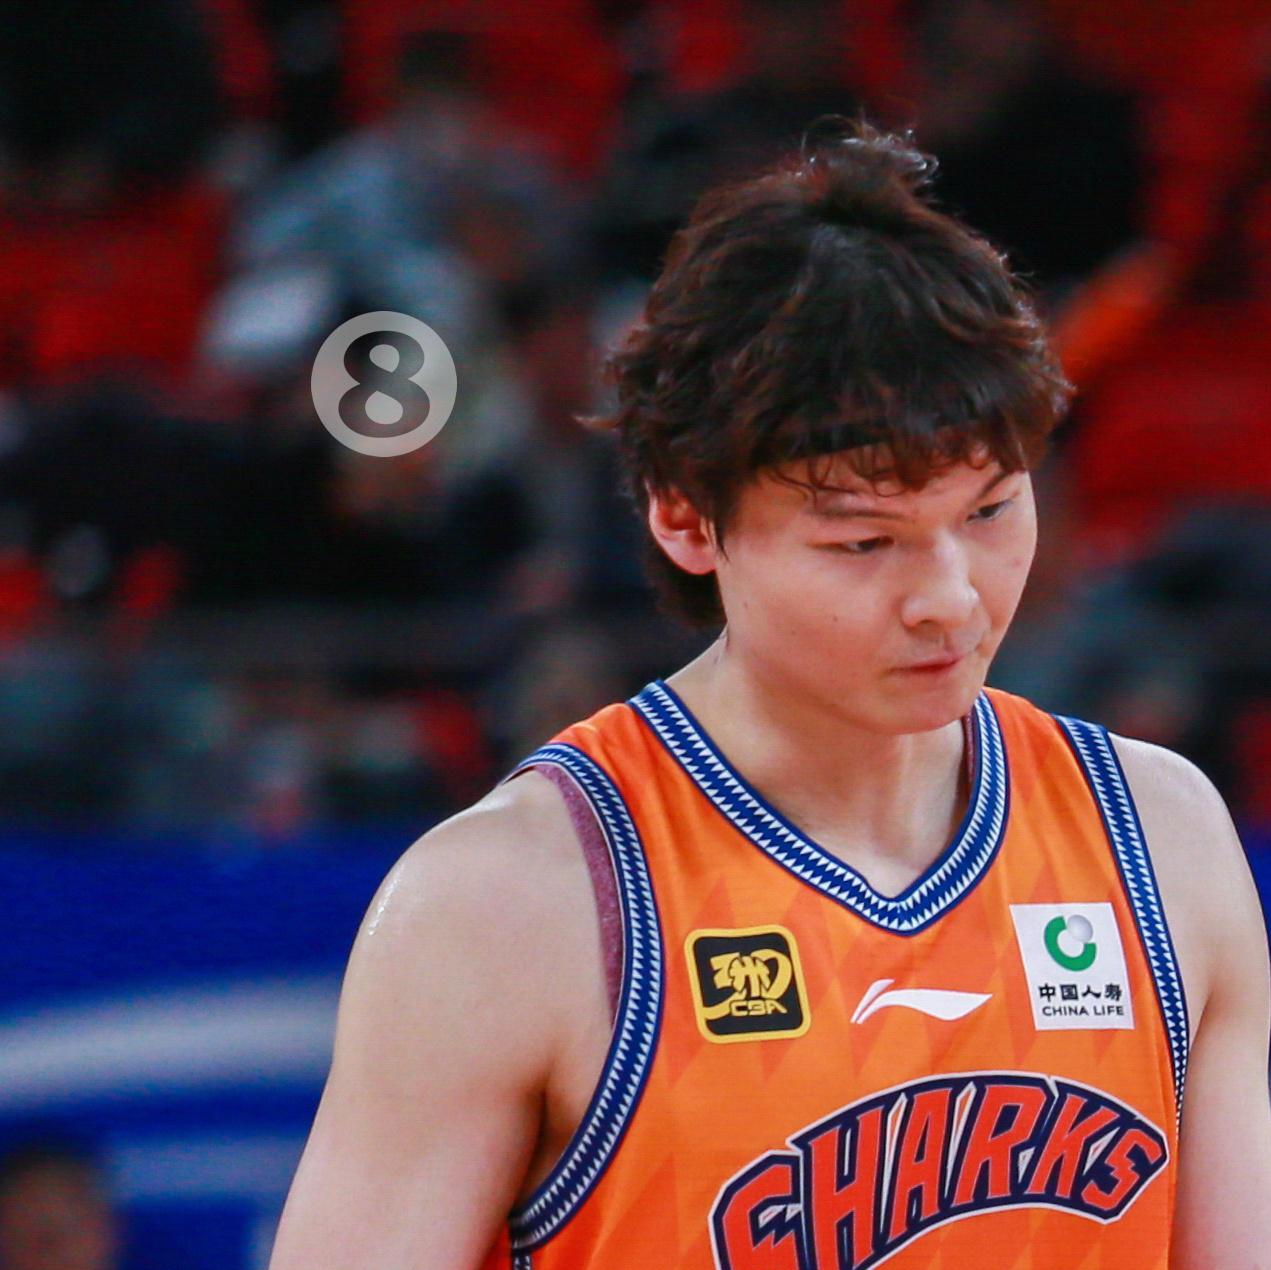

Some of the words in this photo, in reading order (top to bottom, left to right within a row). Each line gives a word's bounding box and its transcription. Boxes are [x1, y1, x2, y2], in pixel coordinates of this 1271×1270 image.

[1038, 982, 1123, 1003] 中国人寿
[730, 999, 788, 1017] CBA
[1041, 1005, 1090, 1017] CHINA
[1093, 1005, 1125, 1017] LIFE
